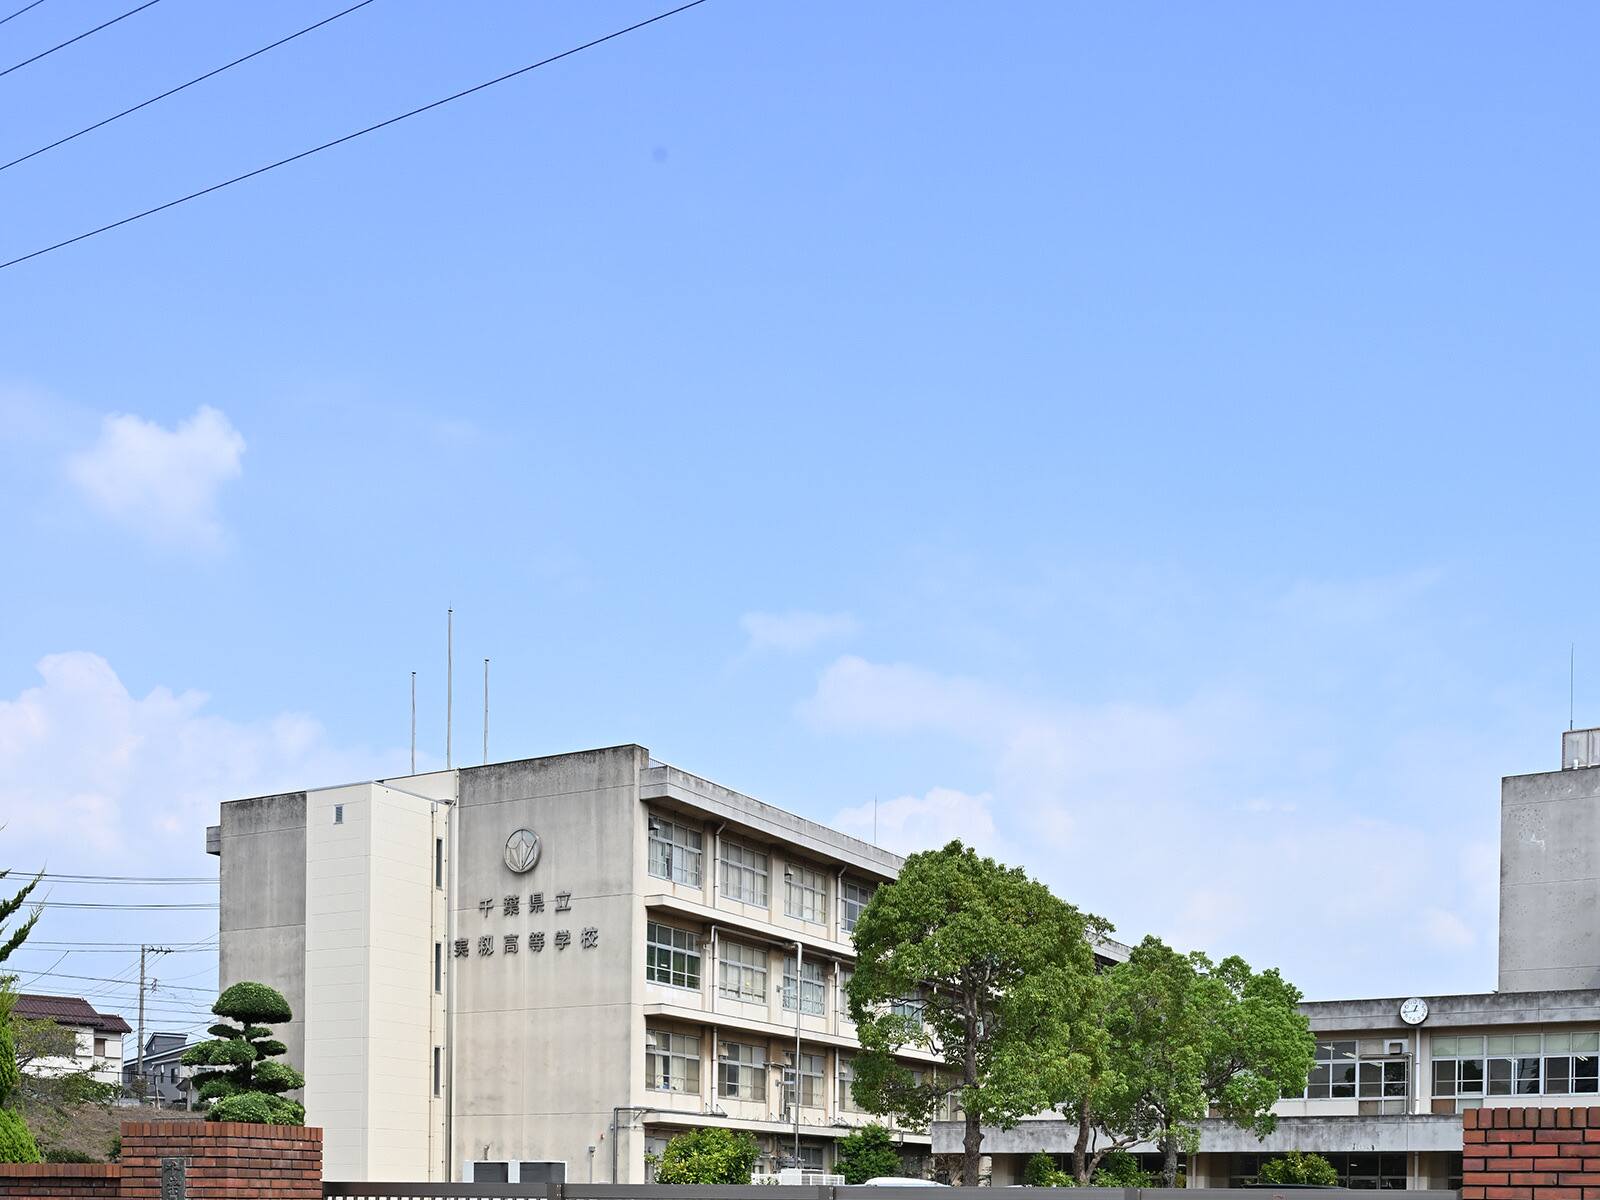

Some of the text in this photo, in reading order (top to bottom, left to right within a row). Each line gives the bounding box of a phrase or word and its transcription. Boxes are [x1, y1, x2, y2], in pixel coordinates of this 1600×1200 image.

[479, 891, 572, 918] 千葉県立
[454, 926, 599, 958] 実籾高等学校
